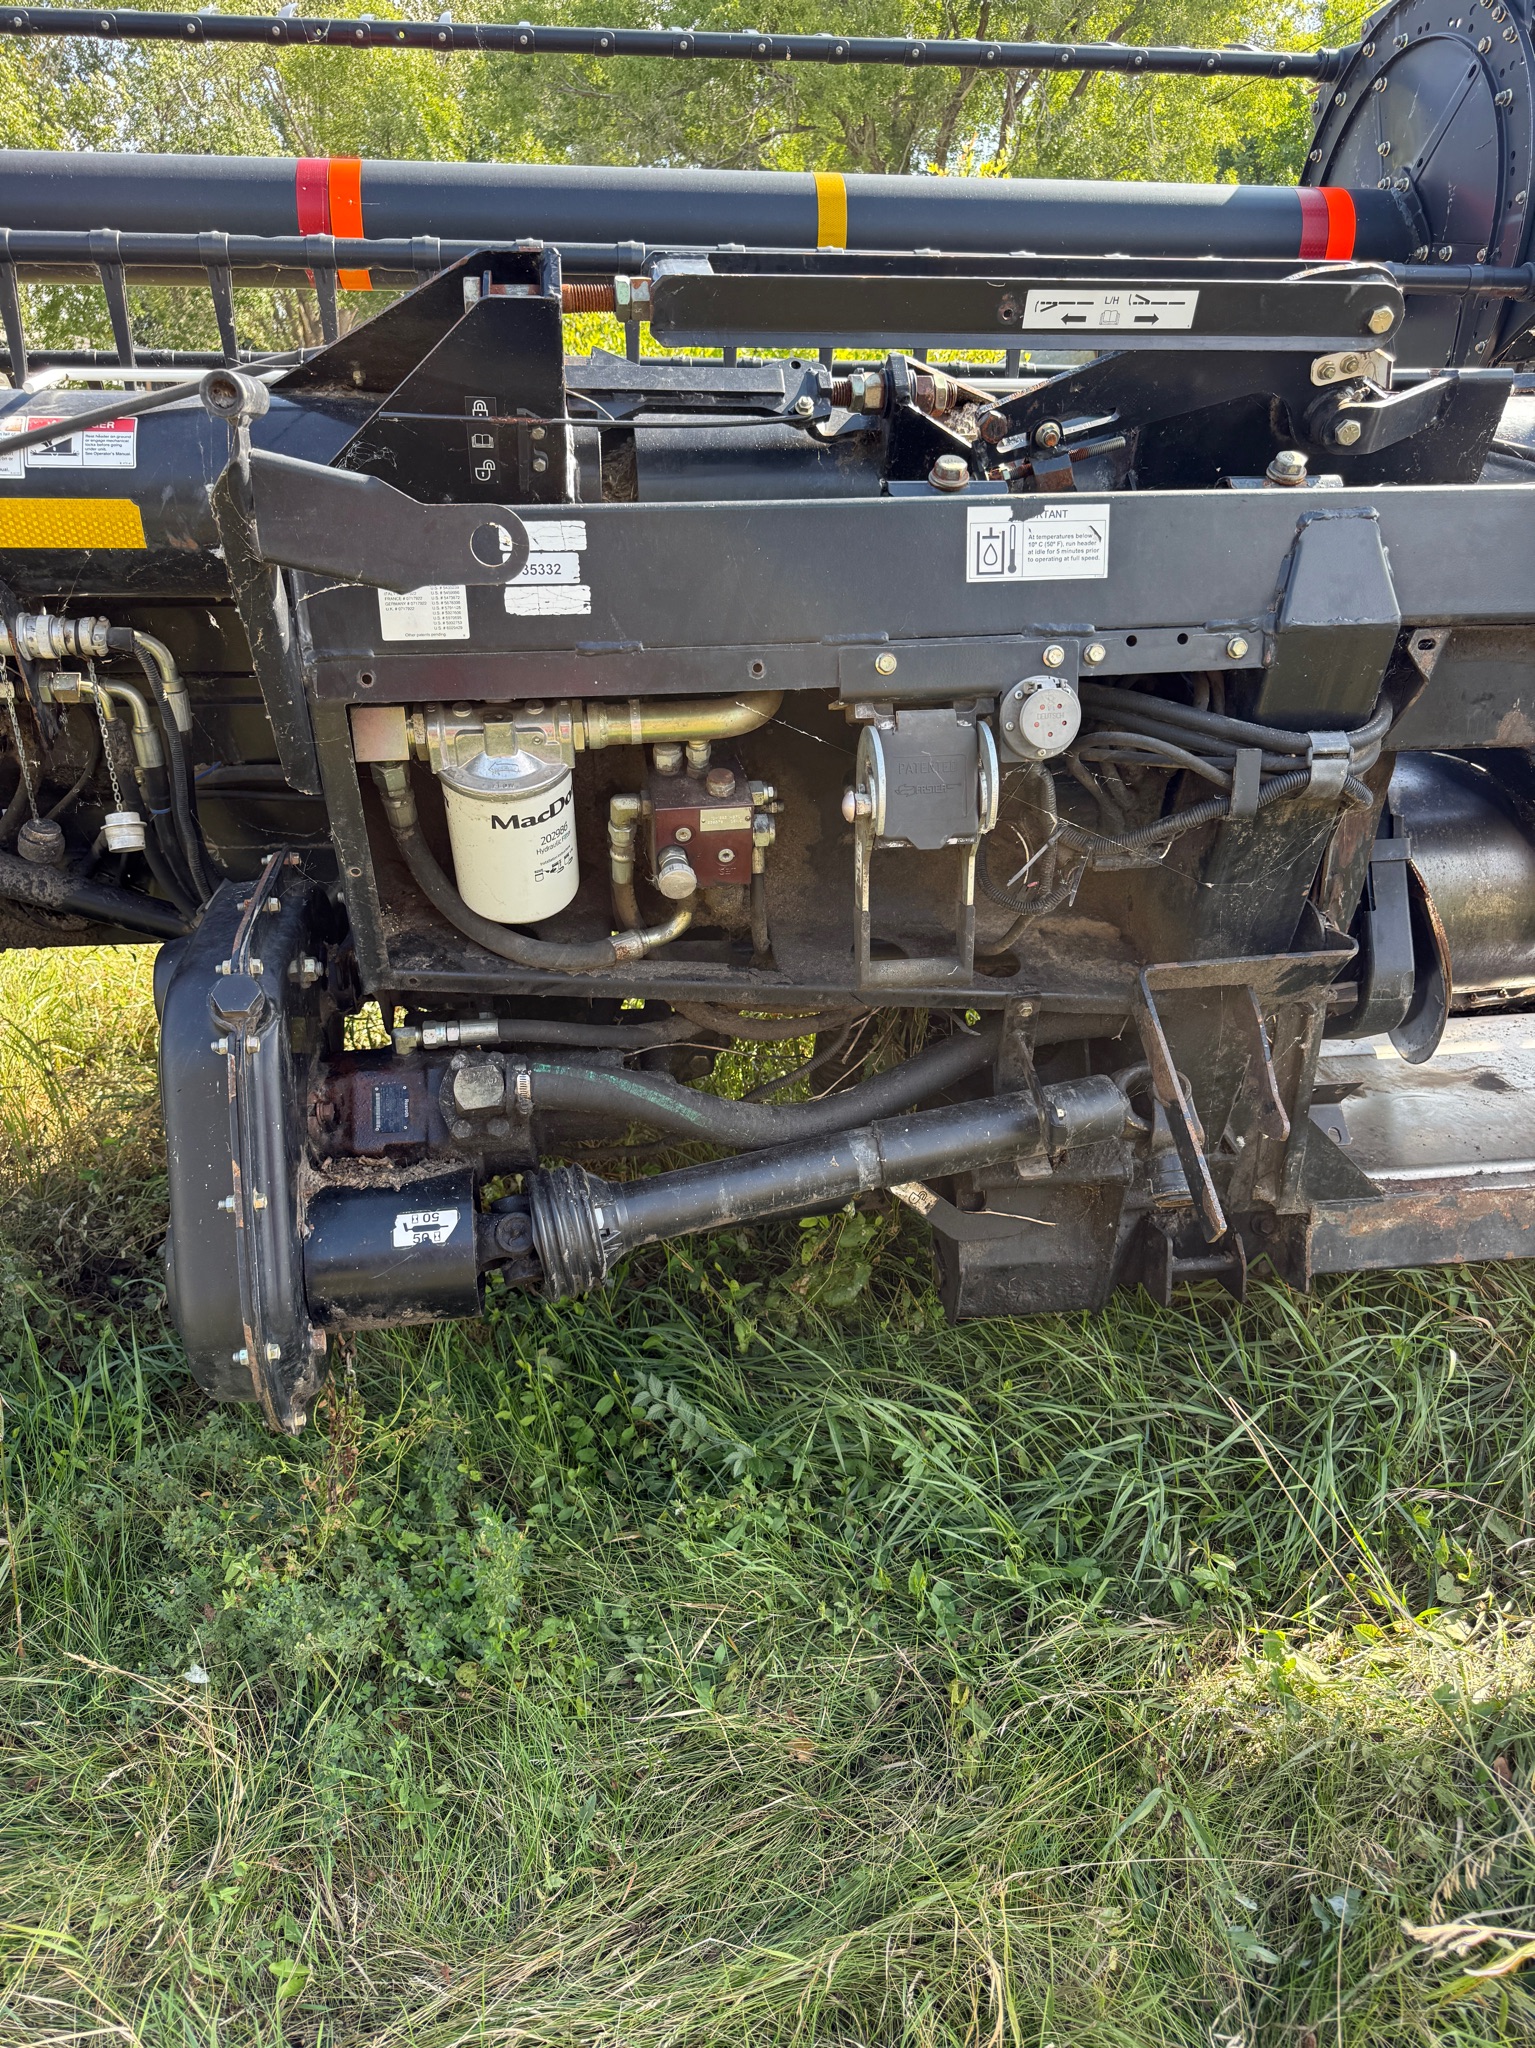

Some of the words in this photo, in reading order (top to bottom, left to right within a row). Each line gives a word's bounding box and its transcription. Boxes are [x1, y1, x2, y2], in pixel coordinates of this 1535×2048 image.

[1104, 296, 1120, 305] L/H
[1081, 554, 1100, 562] speed.
[1037, 712, 1065, 720] DEUTSCH
[898, 761, 958, 775] PATENTED
[491, 787, 573, 830] MacDo
[541, 821, 568, 846] 202986
[536, 839, 562, 855] Hydraulic
[423, 1212, 440, 1223] 50
